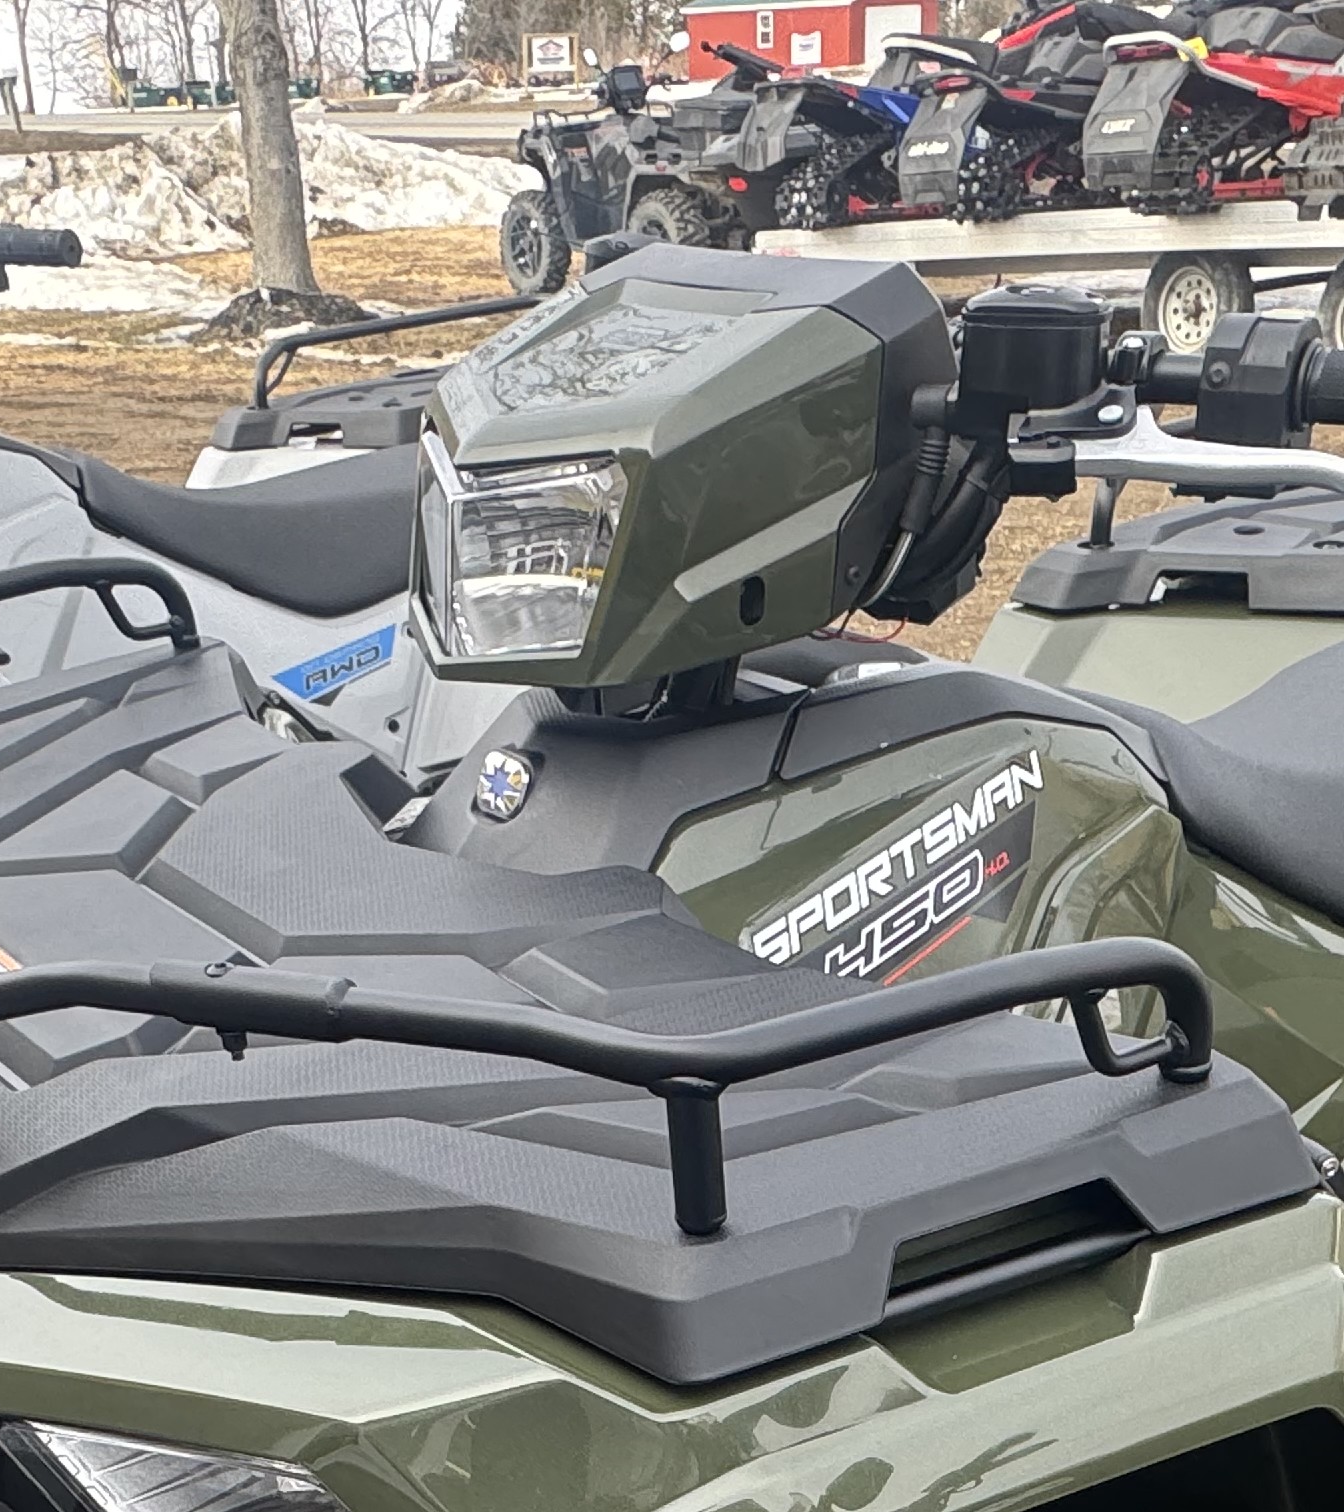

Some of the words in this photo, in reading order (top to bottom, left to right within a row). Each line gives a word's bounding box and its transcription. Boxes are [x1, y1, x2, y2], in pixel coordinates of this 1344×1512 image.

[304, 645, 381, 691] AWD
[752, 748, 1044, 966] SPORTSMAN
[823, 848, 984, 978] 450
